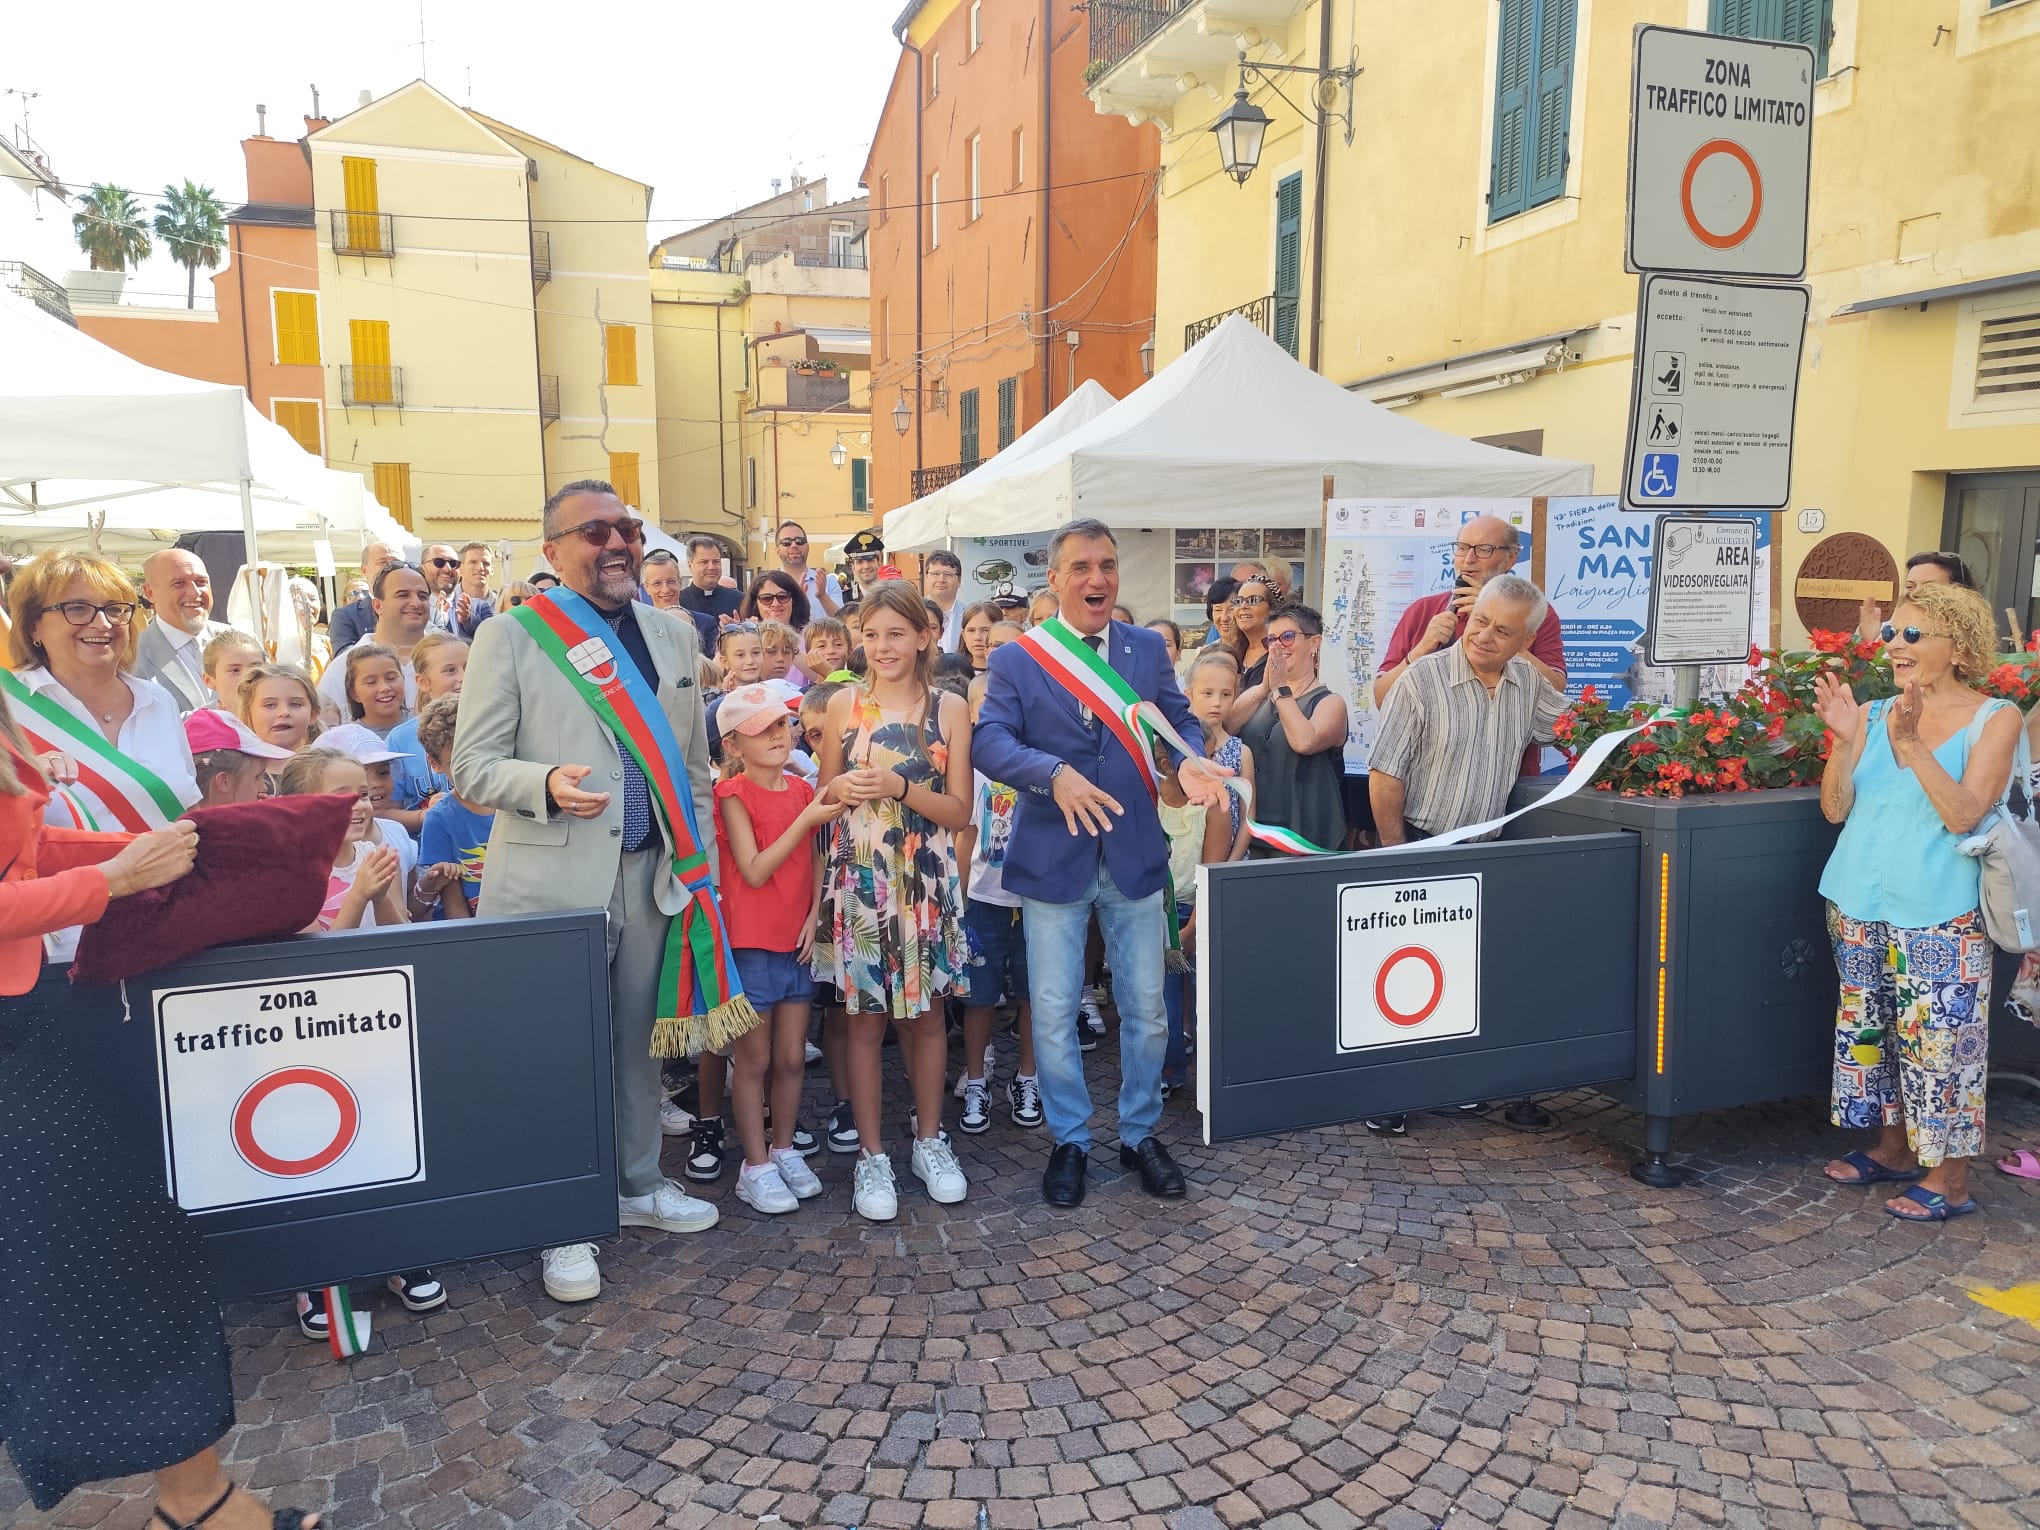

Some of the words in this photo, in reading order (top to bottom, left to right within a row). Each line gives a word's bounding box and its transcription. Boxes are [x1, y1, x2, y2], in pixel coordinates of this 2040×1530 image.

[1704, 58, 1751, 89] ZONA
[1646, 84, 1727, 118] TRAFFICO
[1734, 95, 1806, 127] LIMITATO
[1658, 287, 1680, 297] divieto
[1682, 290, 1688, 298] di
[1690, 291, 1713, 300] transito
[1656, 313, 1686, 321] eccetto:
[1569, 506, 1595, 518] FIERA
[1597, 501, 1616, 511] delle
[1578, 524, 1650, 550] SAN
[1716, 526, 1742, 534] Comune
[989, 539, 1029, 547] SPORTIVE!
[1706, 537, 1749, 545] LAIGUEGLIA
[1716, 546, 1749, 566] AREA
[1663, 574, 1749, 588] VIDEOSORVEGLIATA
[1395, 888, 1427, 903] zona
[1347, 911, 1407, 932] traffico
[1413, 904, 1473, 925] limitato
[259, 989, 318, 1012] zona
[174, 1023, 283, 1053] traffico
[295, 1009, 402, 1040] limitato
